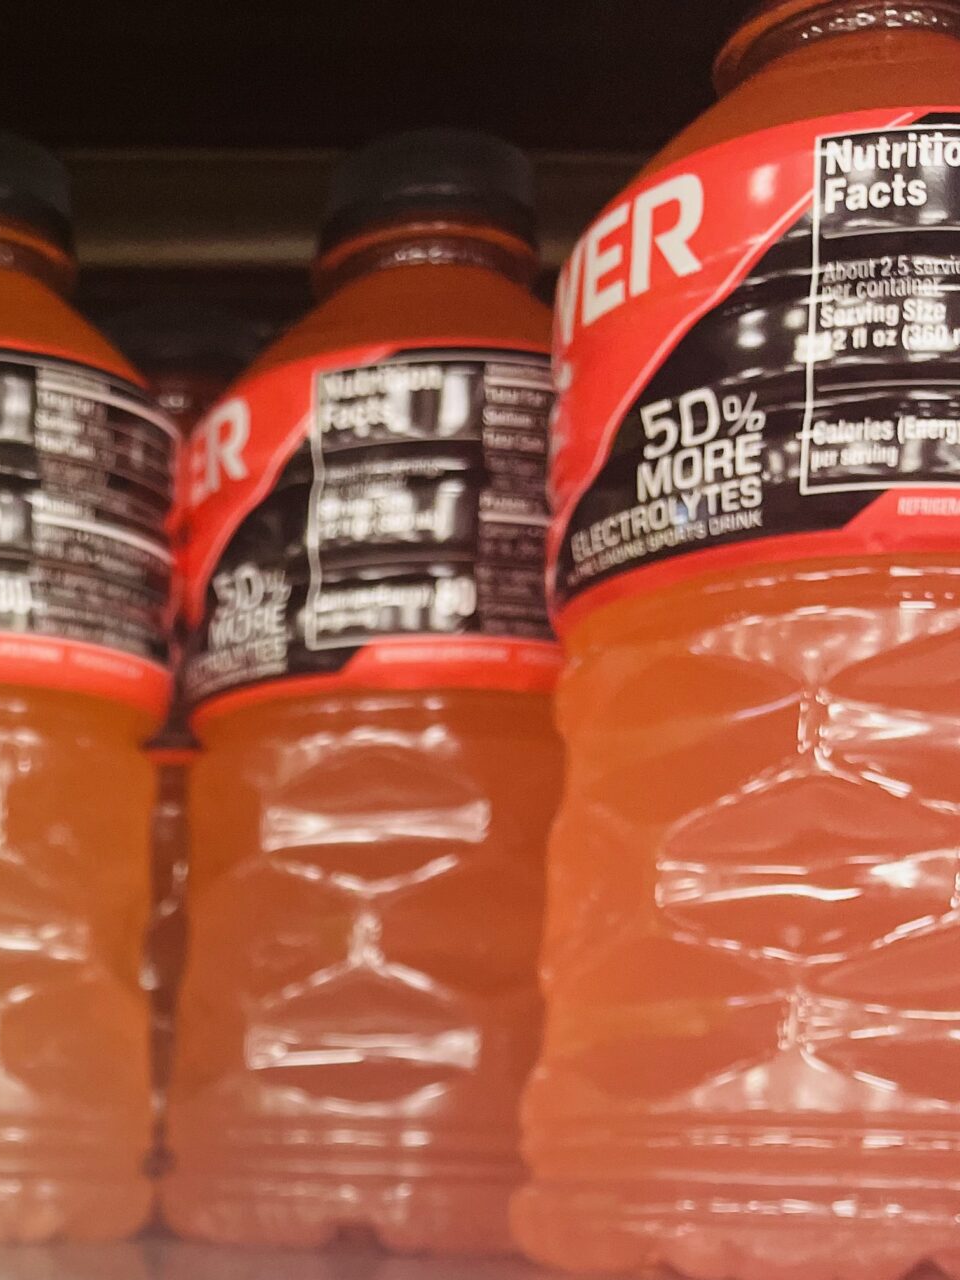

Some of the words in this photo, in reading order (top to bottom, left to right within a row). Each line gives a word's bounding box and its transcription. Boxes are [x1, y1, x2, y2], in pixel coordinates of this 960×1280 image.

[824, 173, 927, 213] Facts
[822, 257, 877, 283] About
[880, 255, 910, 278] 2.5
[822, 282, 853, 302] per
[856, 275, 941, 299] container
[820, 301, 899, 328] Serving
[902, 298, 947, 323] Size
[852, 326, 868, 349] fl
[872, 329, 897, 348] oz
[640, 387, 767, 460] 50%
[813, 418, 894, 445] Calories
[637, 432, 763, 502] MORE
[570, 475, 763, 563] ELECTROLYTES
[708, 510, 763, 537] DRINK
